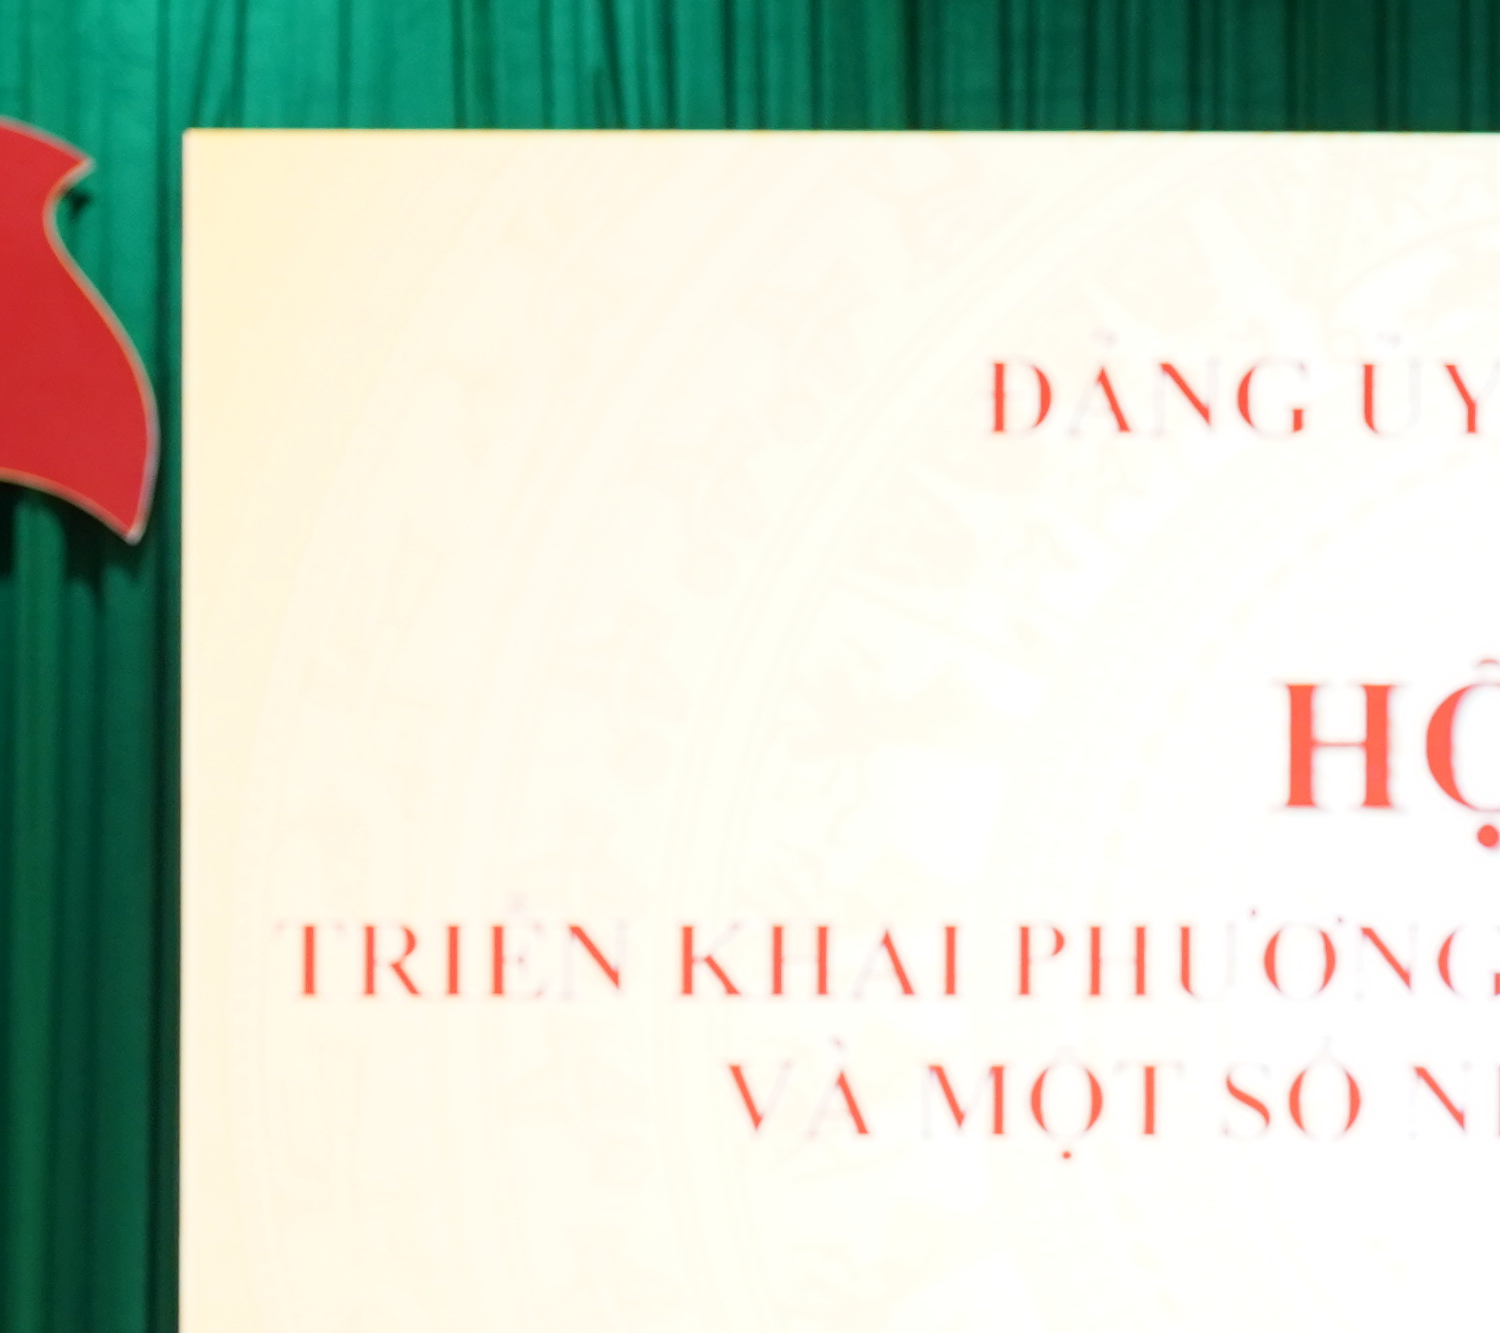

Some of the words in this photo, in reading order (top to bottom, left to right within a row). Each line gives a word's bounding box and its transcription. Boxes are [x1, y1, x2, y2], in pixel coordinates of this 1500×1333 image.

[674, 919, 963, 1001] KHAI
[721, 1034, 875, 1141] VÀ
[920, 1046, 1185, 1164] MỘT
